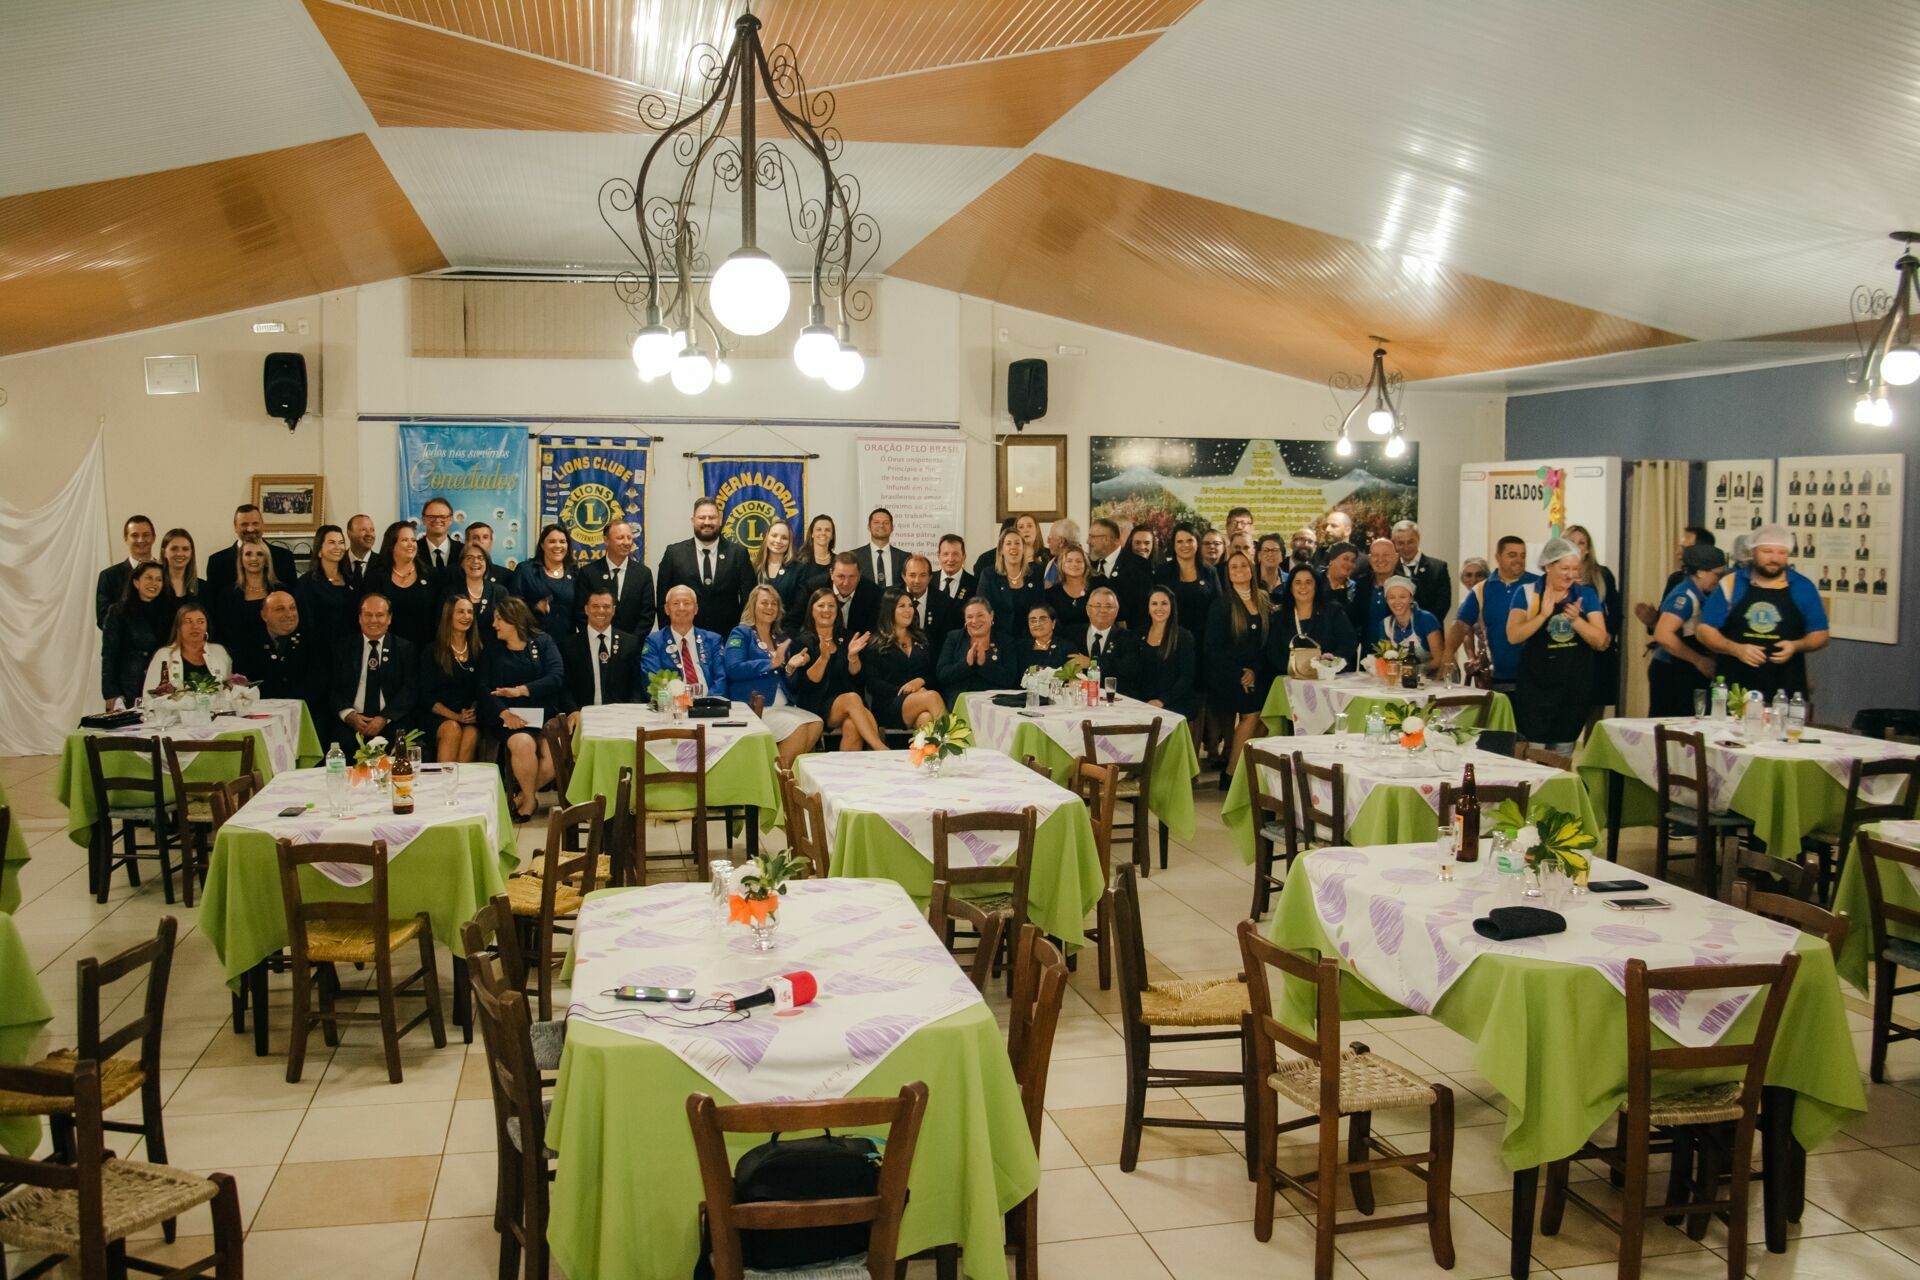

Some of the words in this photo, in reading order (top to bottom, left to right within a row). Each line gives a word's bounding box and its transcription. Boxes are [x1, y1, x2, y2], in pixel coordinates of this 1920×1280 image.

[864, 443, 902, 453] ORAÇÃO
[905, 444, 927, 453] PELO
[409, 459, 518, 492] Conectados
[553, 456, 590, 480] LIONS
[593, 456, 633, 482] CLUBE
[573, 485, 611, 499] LIONS
[716, 471, 799, 519] OVERNADORIA
[1494, 483, 1543, 501] RECADOS
[585, 503, 602, 524] L
[735, 502, 772, 515] LIONS
[747, 520, 764, 541] L
